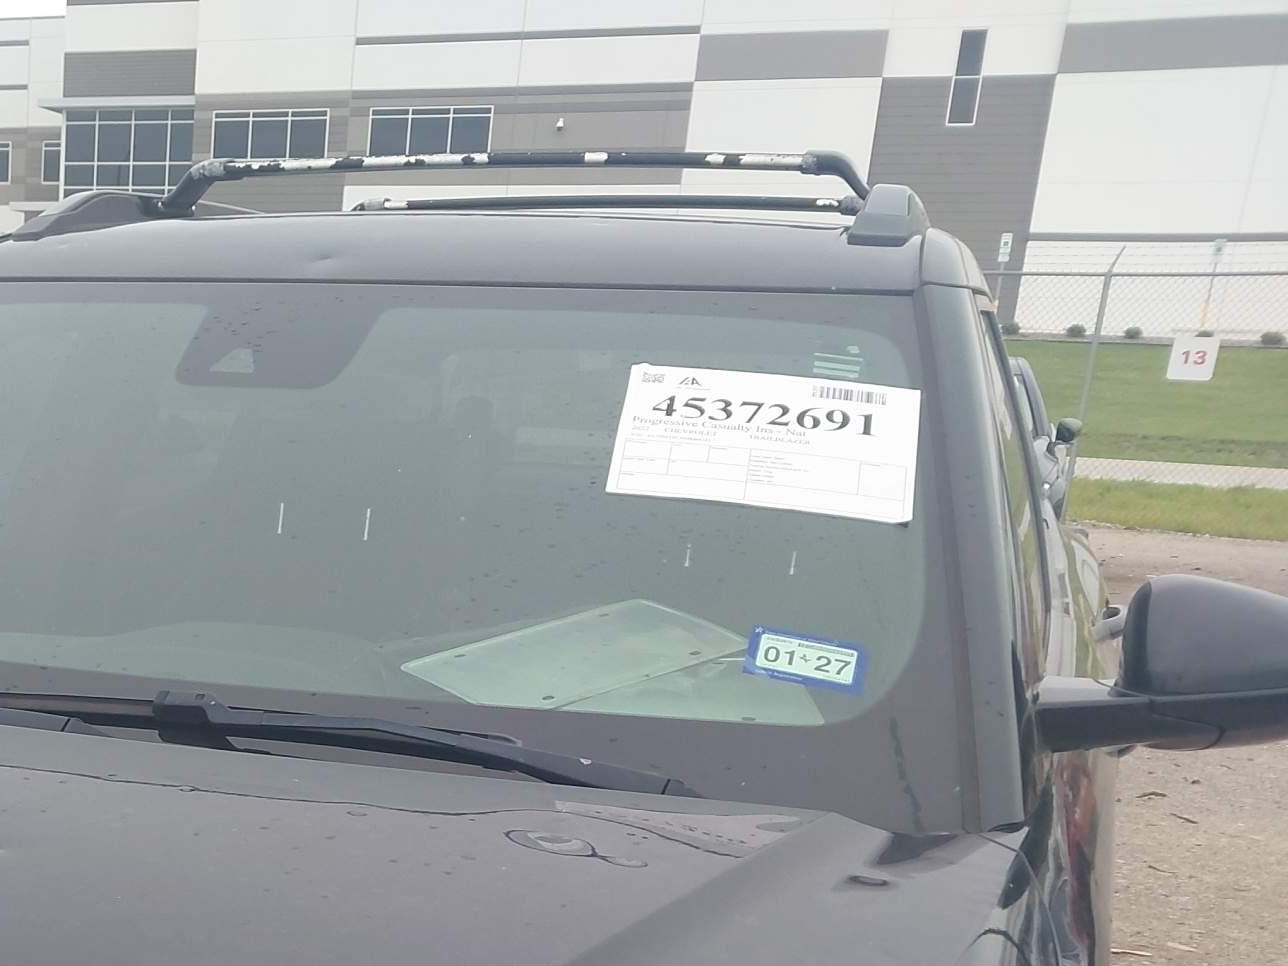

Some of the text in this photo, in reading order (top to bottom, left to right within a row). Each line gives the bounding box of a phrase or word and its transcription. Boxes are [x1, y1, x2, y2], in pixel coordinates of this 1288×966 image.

[1181, 350, 1207, 365] 13
[632, 415, 698, 427] Progressive
[702, 420, 751, 433] Casualty
[786, 428, 806, 437] Nat
[652, 394, 876, 436] 45372691
[764, 645, 796, 666] 01
[813, 655, 852, 676] 27
